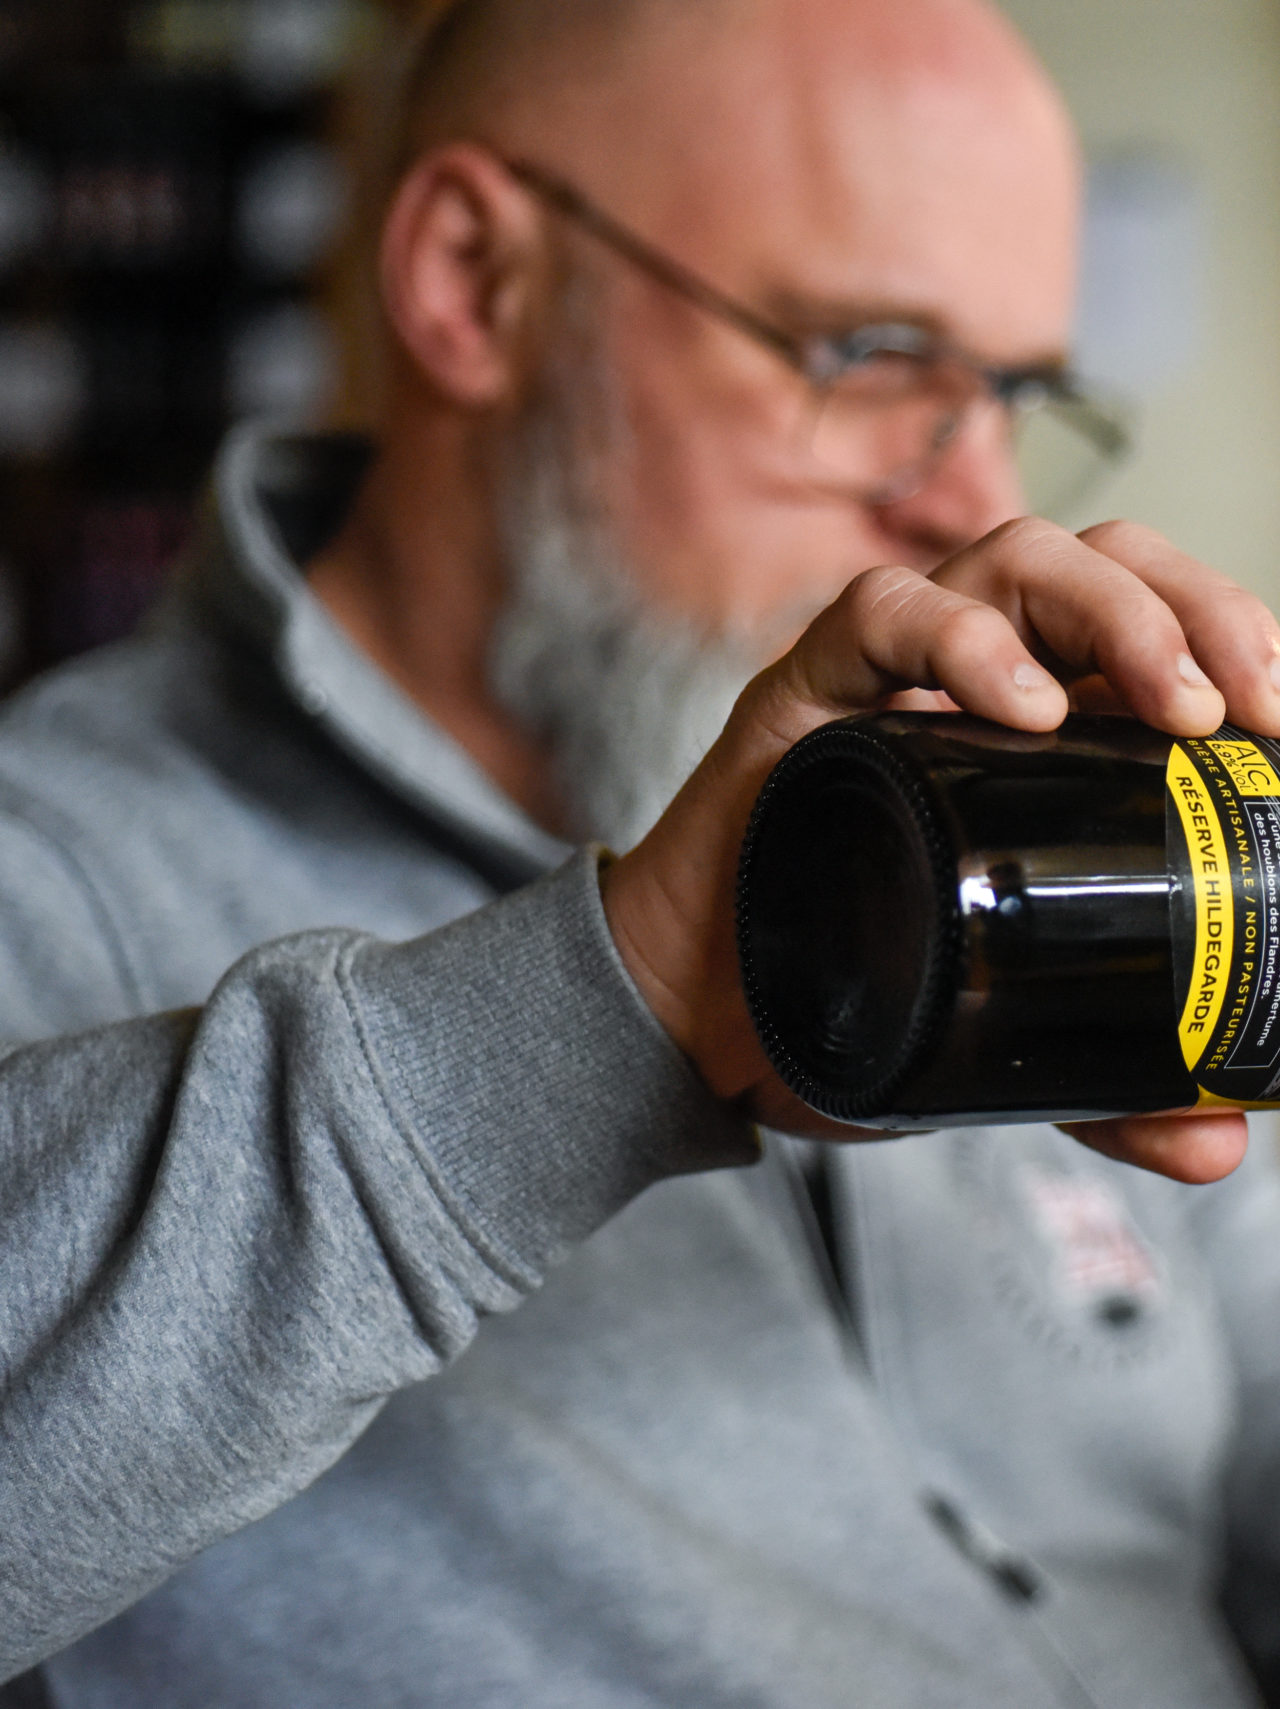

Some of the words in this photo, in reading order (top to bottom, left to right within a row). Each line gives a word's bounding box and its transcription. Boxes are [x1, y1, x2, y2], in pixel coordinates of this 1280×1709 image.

[1187, 740, 1220, 773] BIÈRE
[1225, 744, 1271, 792] Alc.
[1232, 769, 1252, 792] Vol.
[1176, 776, 1218, 873] RÉSERVE
[1216, 778, 1255, 888] ARTISANALE
[1254, 813, 1267, 836] des
[1262, 840, 1276, 903] houblons
[1245, 912, 1256, 953] NON
[1269, 908, 1279, 932] des
[1188, 880, 1222, 1033] HILDEGARDE
[1261, 937, 1279, 999] Flandres.
[1206, 962, 1254, 1070] PASTEURISÉE
